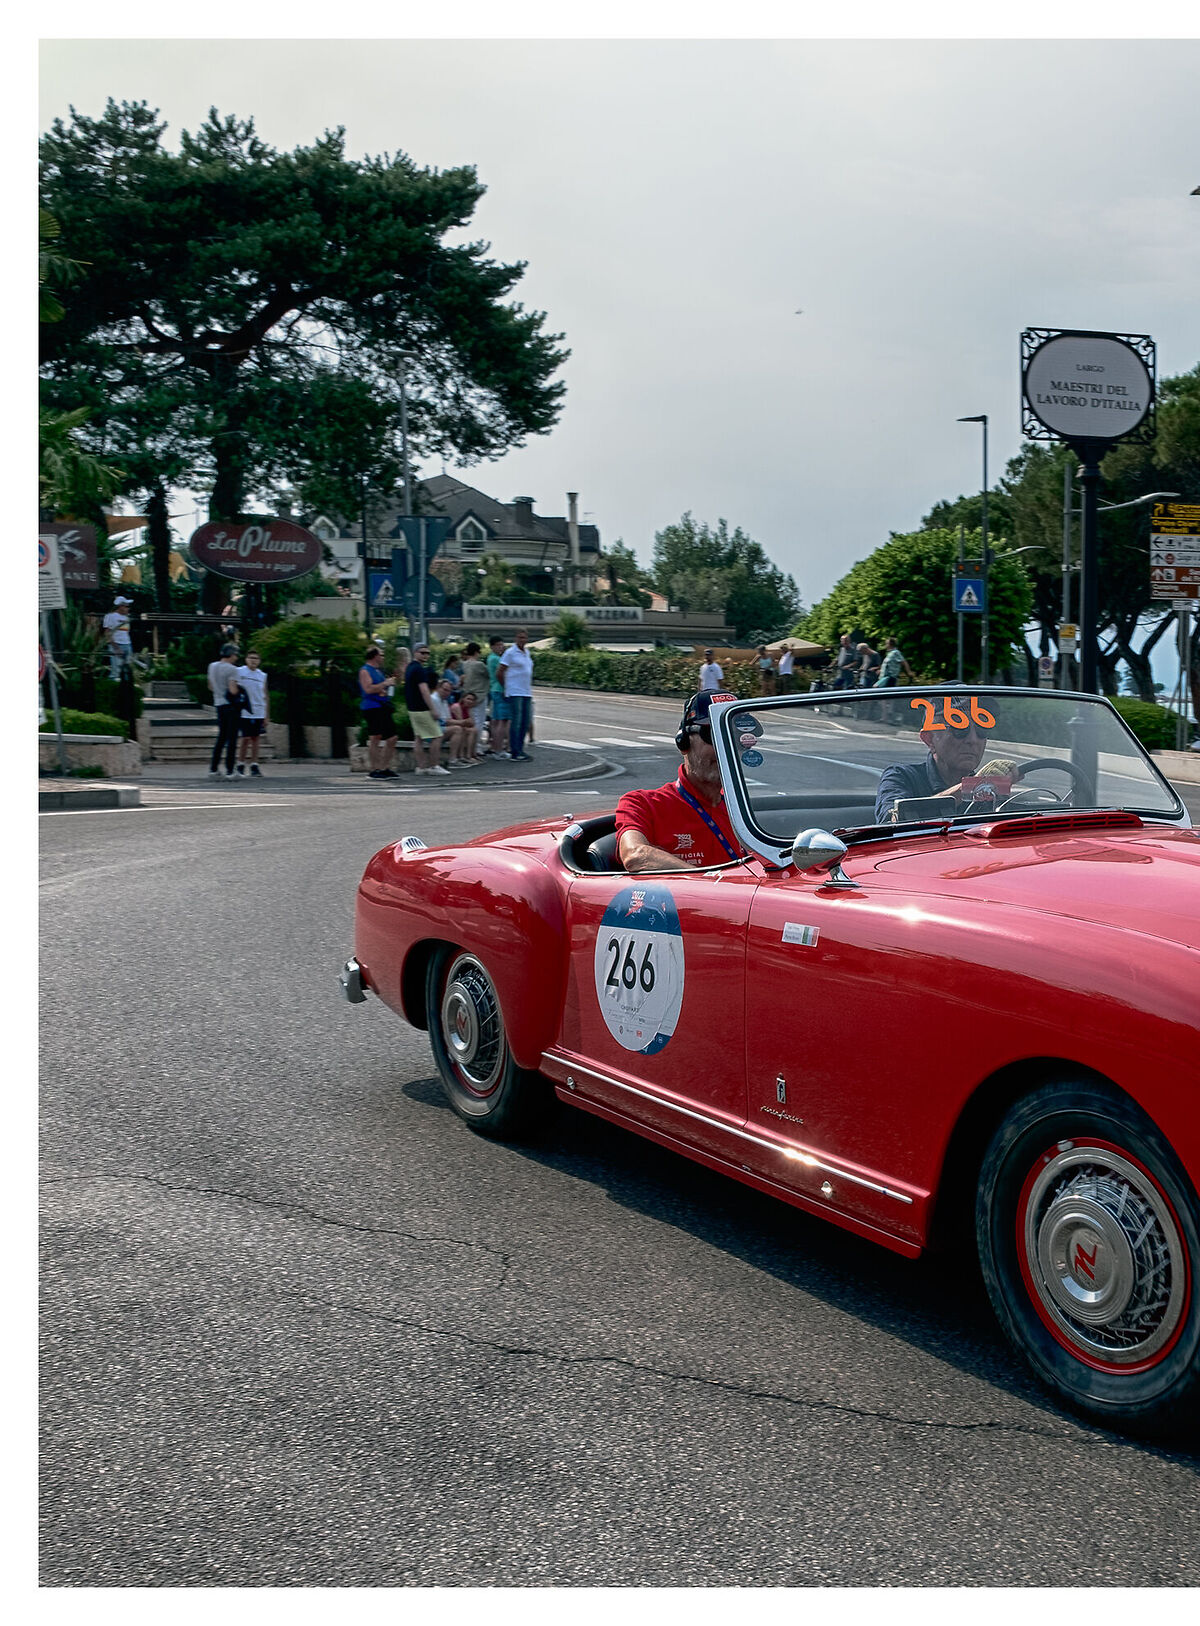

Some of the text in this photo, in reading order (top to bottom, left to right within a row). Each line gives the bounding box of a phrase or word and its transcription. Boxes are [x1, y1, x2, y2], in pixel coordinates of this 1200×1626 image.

[1076, 364, 1105, 373] LARGO
[1050, 381, 1129, 396] MAESTRI DEL
[1036, 394, 1142, 411] LAVORO D'ITALIA
[207, 526, 307, 557] La Plume
[467, 609, 544, 621] RISTORANTE
[586, 609, 640, 621] PIZZERIA
[910, 697, 996, 732] 266
[606, 938, 655, 993] 266
